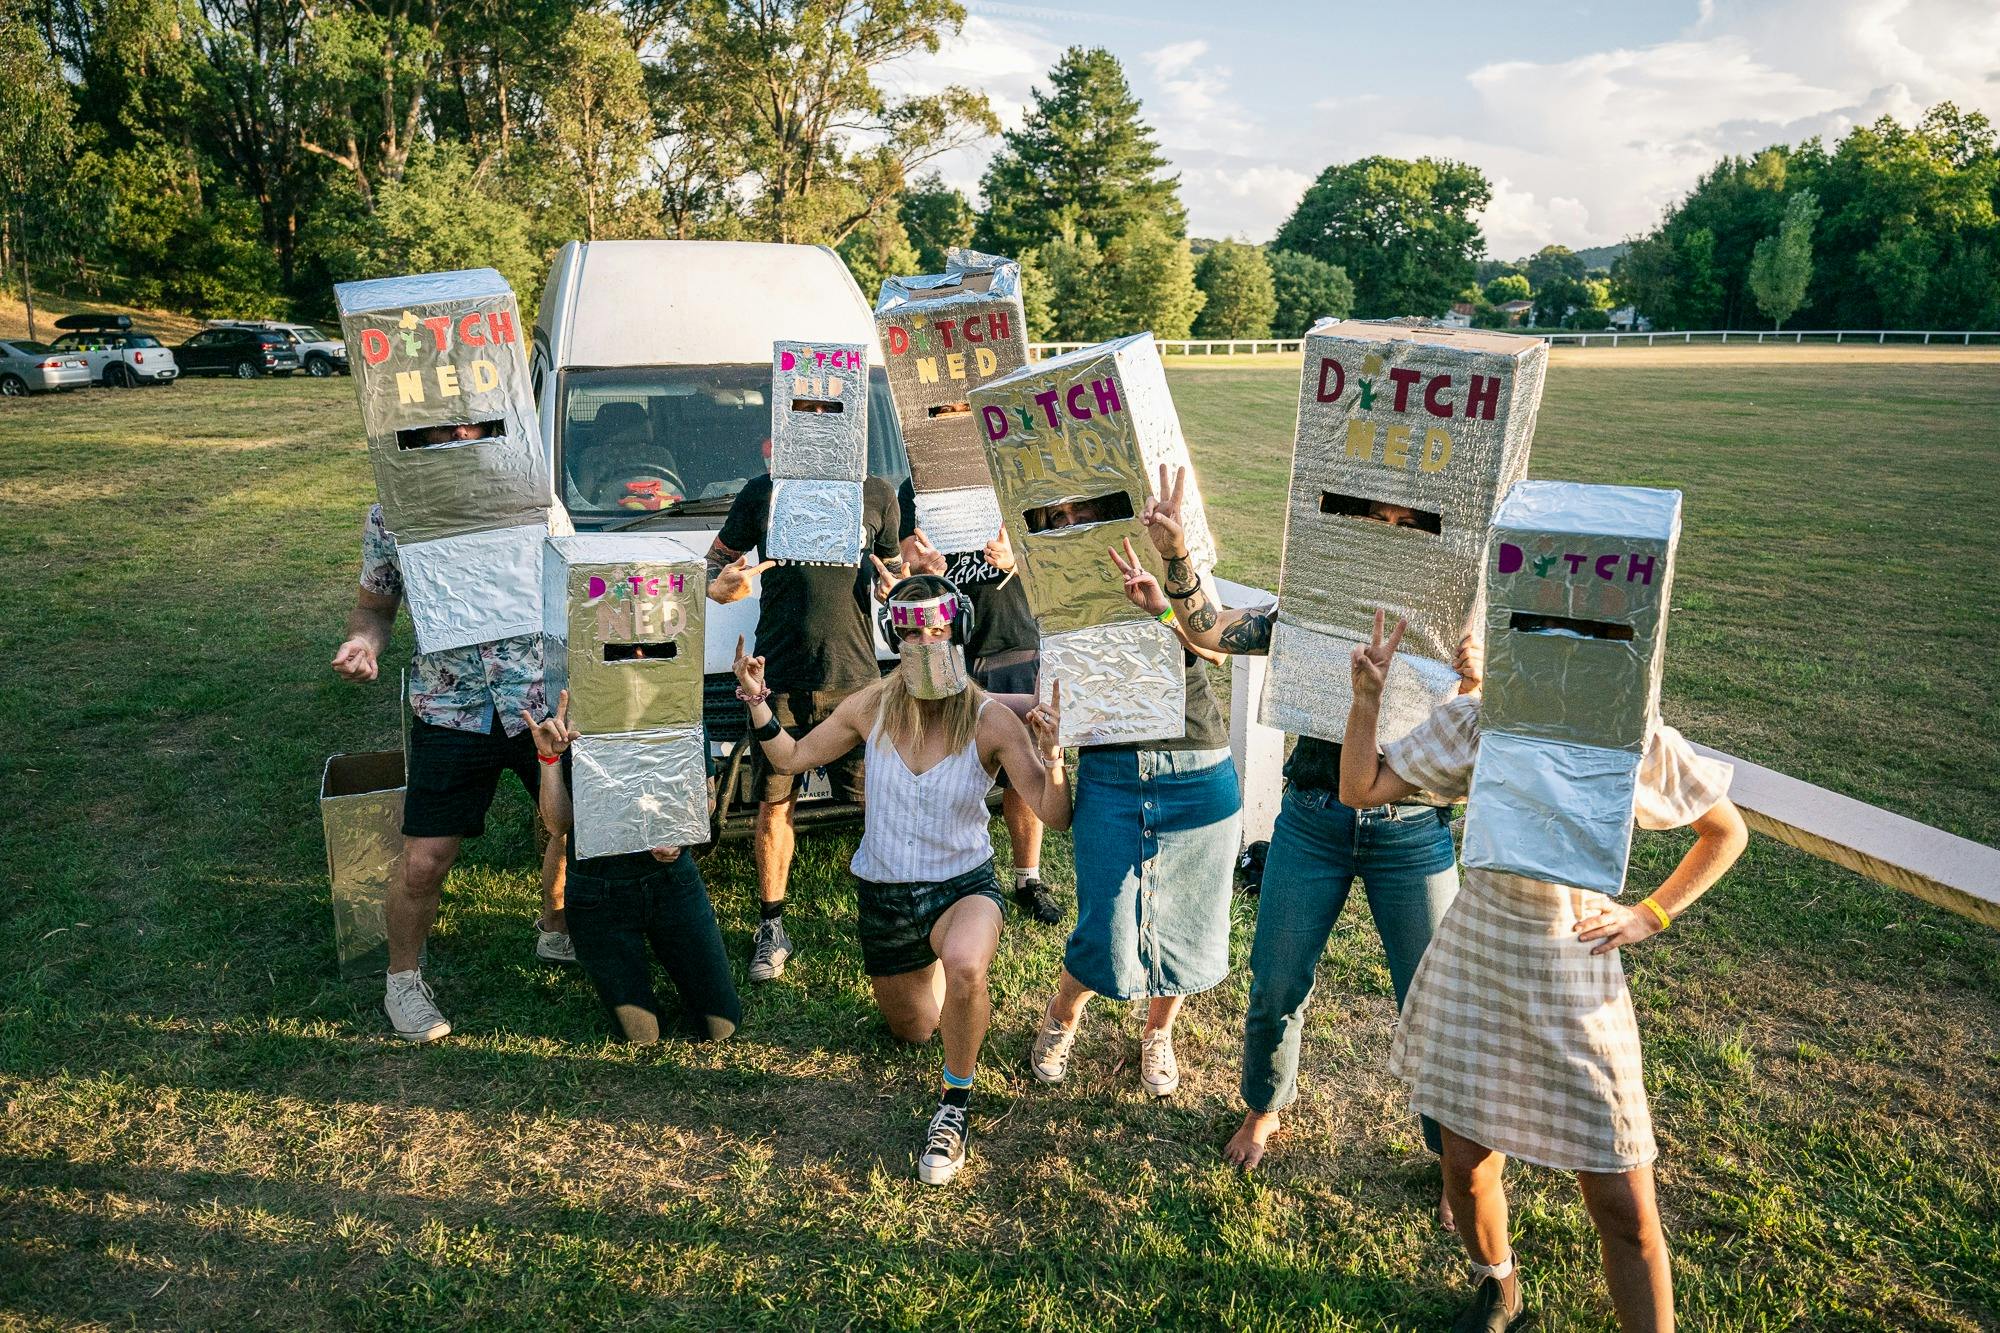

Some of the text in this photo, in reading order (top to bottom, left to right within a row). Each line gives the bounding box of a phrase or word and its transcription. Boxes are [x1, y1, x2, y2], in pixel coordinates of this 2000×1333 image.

[396, 360, 499, 404] NED
[916, 348, 998, 385] NED
[1019, 430, 1106, 481] NED
[1345, 419, 1453, 473] NED
[1537, 579, 1627, 617] NED
[596, 599, 687, 640] NED
